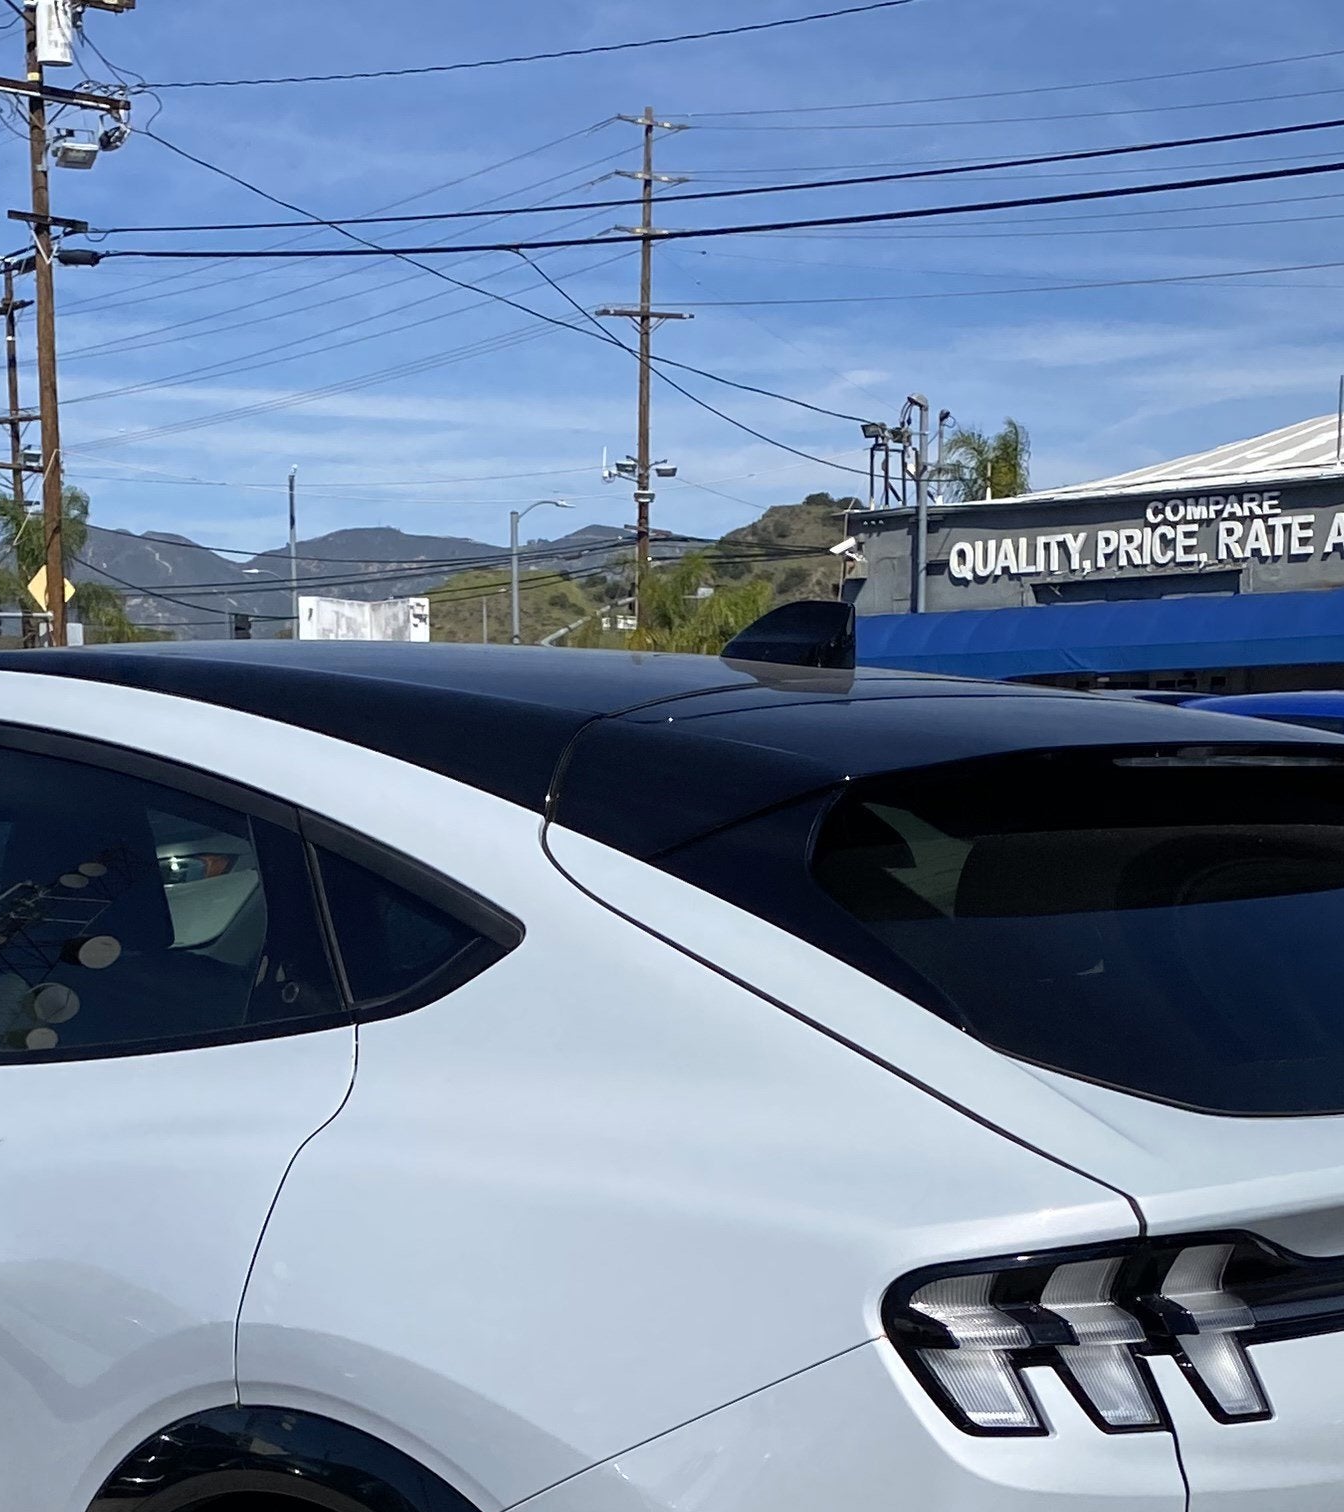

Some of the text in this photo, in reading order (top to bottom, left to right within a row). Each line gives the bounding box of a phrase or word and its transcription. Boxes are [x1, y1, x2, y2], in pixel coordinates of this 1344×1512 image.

[1145, 491, 1282, 524] COMPARE
[949, 532, 1091, 581] QUALITY,
[1096, 523, 1208, 569] PRICE,
[1217, 514, 1315, 560] RATE
